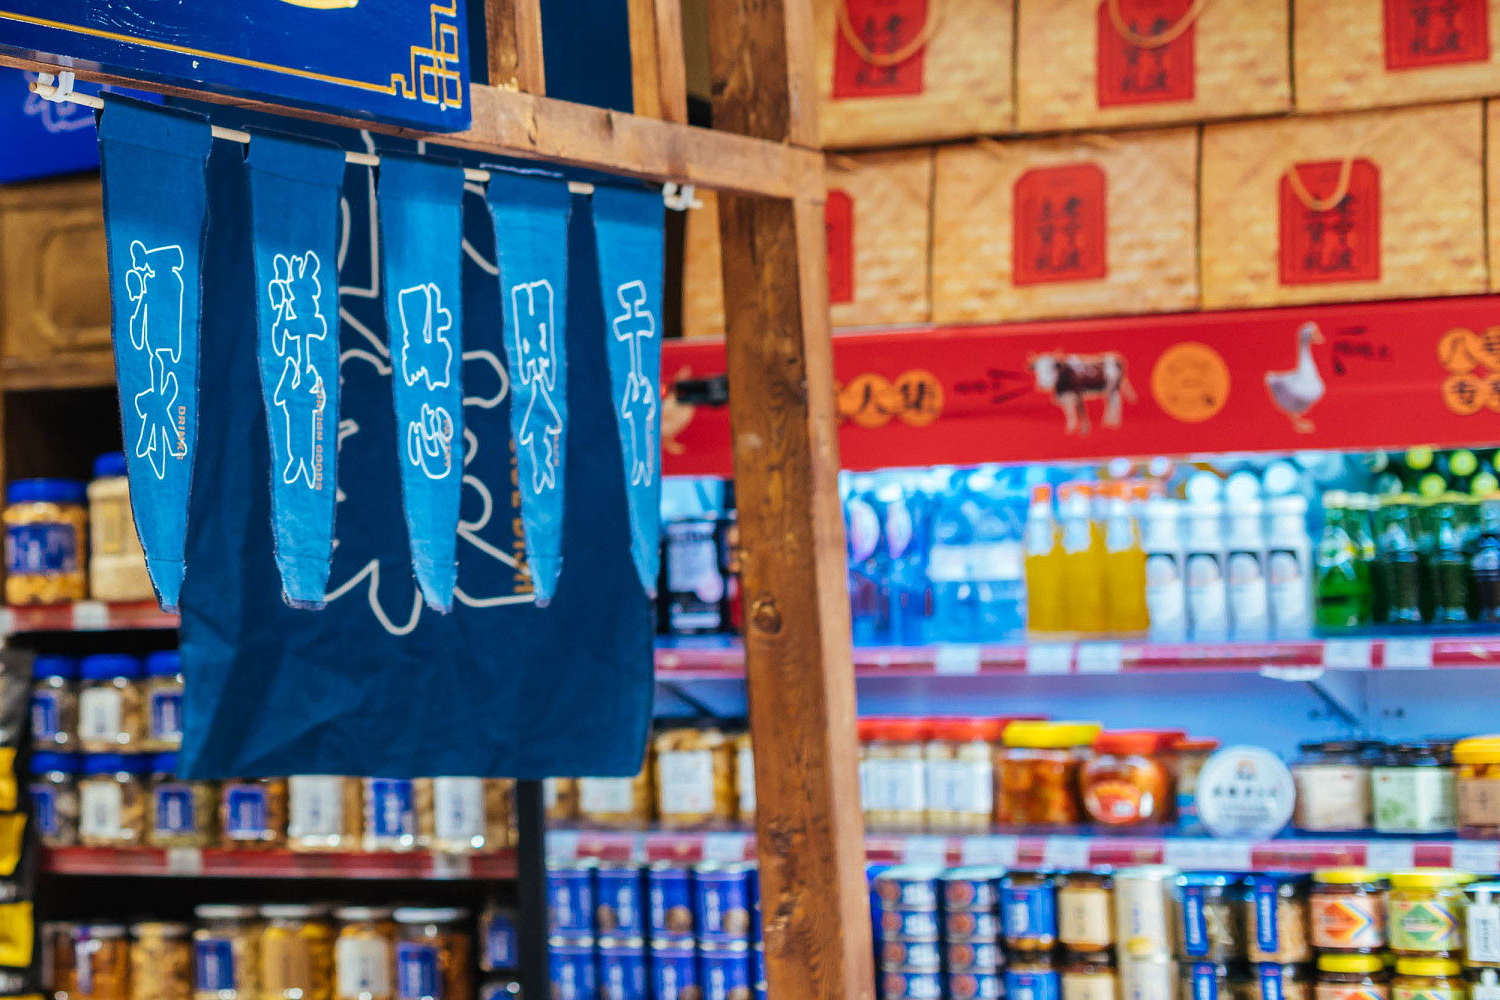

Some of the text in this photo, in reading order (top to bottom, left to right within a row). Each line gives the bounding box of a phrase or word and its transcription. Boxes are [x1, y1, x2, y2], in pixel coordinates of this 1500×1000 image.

[125, 240, 188, 480] 酒水
[176, 405, 188, 461] DRINKS
[314, 444, 324, 492] GOODS
